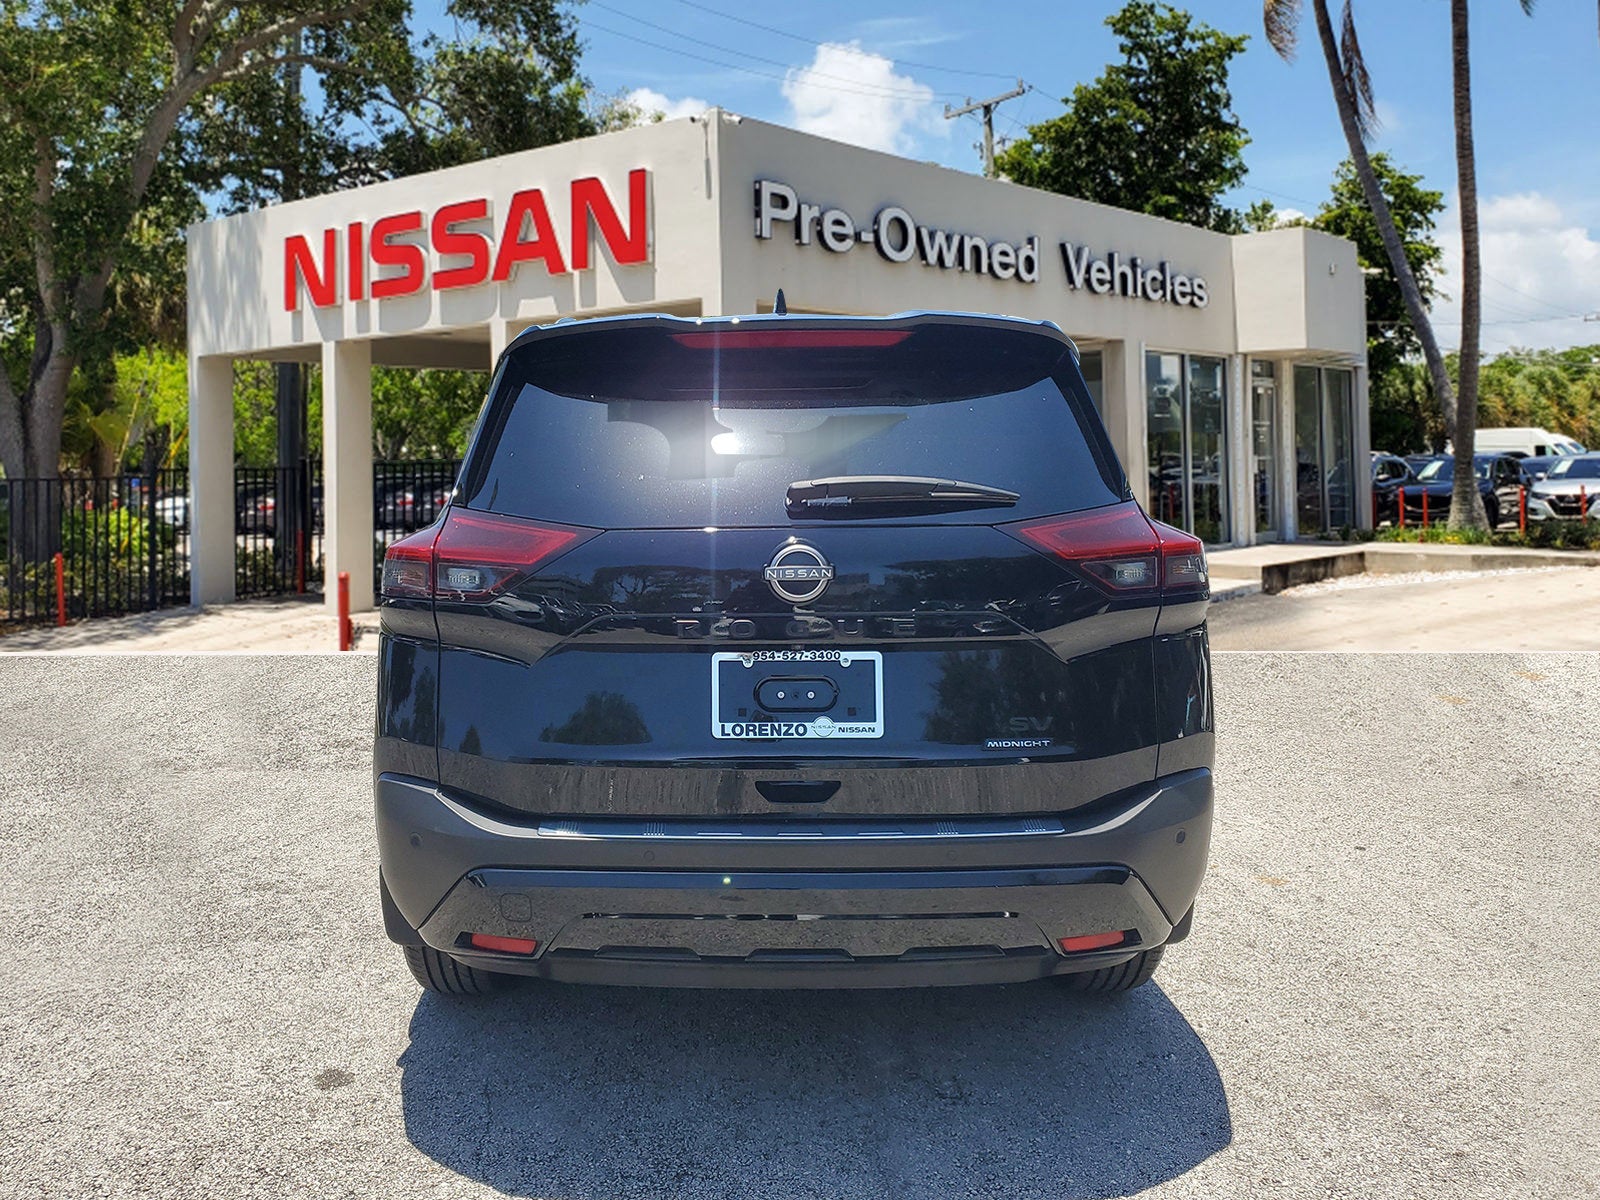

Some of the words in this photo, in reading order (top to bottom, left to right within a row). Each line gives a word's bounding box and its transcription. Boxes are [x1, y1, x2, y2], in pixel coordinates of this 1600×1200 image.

[284, 168, 649, 312] NISSAN
[755, 179, 1040, 284] Pre-Owned
[1060, 241, 1209, 308] Vehicles
[765, 567, 833, 579] NISSAN
[752, 650, 841, 661] 954-527-3400
[720, 723, 808, 737] LORENZO
[1010, 716, 1054, 731] SV
[987, 740, 1051, 748] MIDNIGHT
